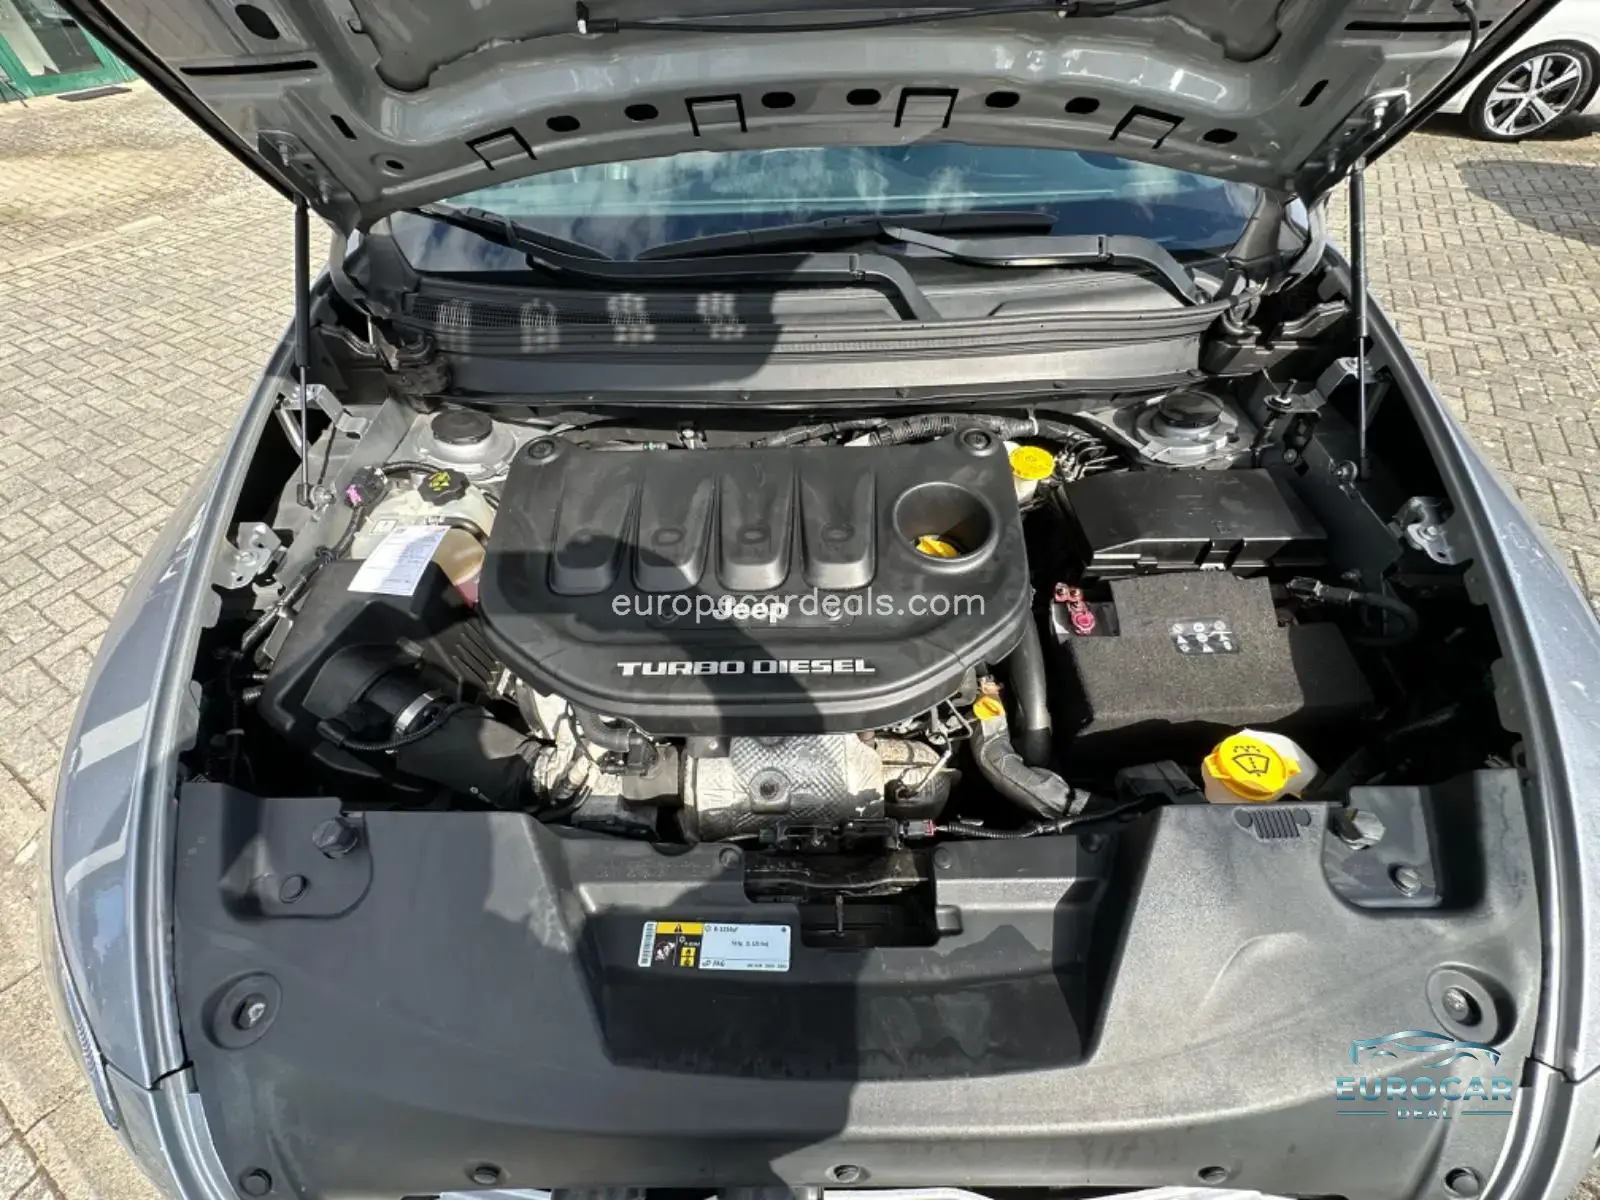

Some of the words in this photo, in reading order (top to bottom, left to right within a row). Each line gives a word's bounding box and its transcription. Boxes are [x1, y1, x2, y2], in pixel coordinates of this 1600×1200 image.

[712, 597, 788, 624] Jeep
[617, 660, 745, 677] TURBO
[752, 657, 876, 675] DIESEL
